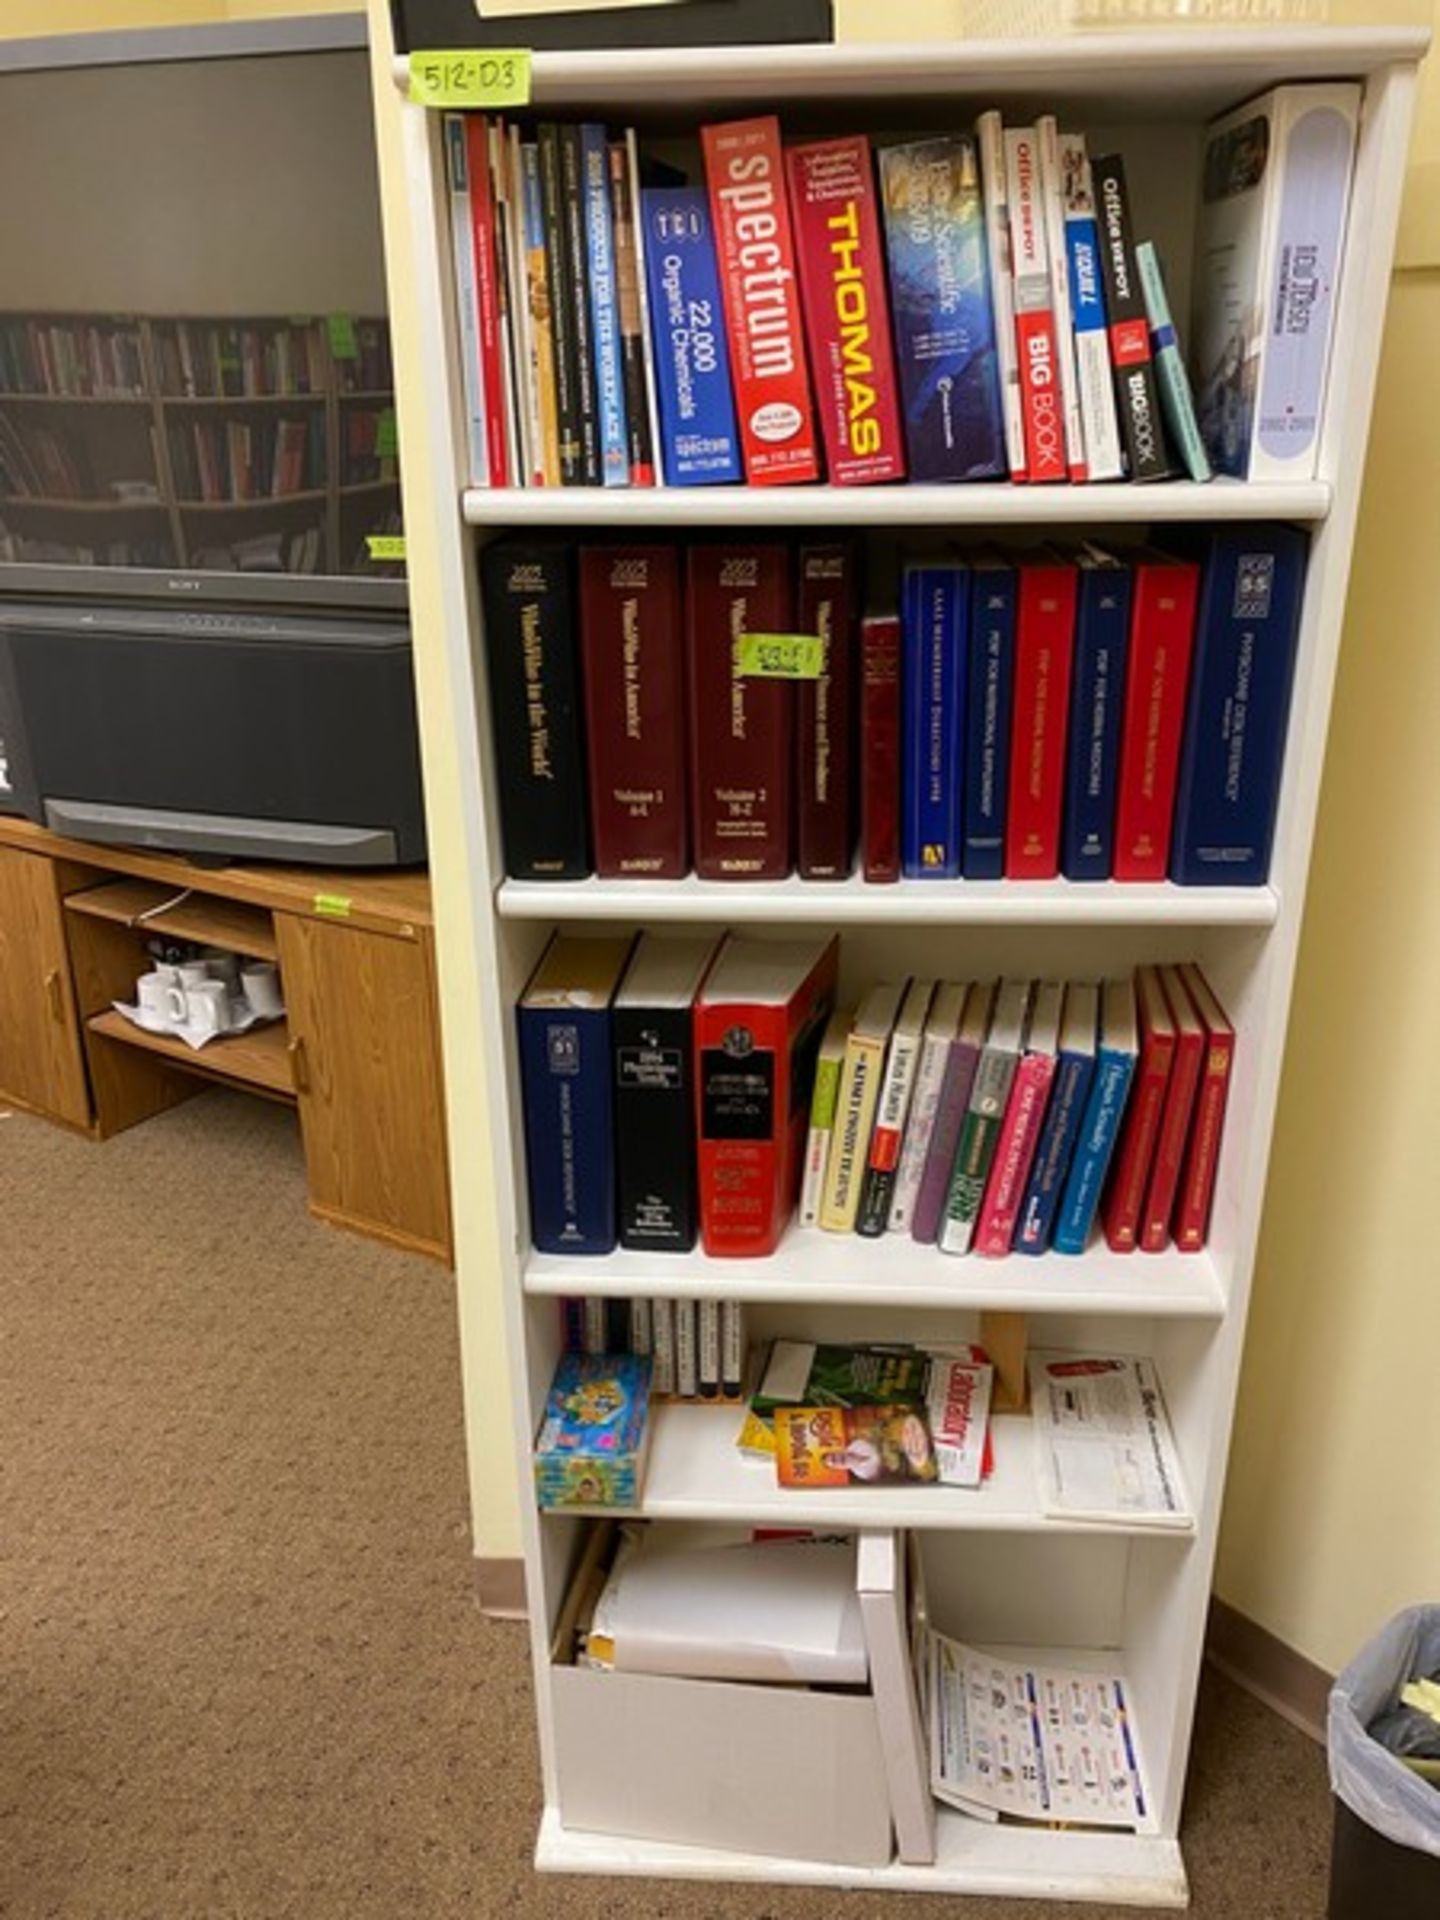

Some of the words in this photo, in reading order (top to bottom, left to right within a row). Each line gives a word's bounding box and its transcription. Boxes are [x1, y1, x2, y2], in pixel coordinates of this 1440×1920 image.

[663, 255, 686, 324] Organic
[719, 155, 796, 378] spectrum
[688, 302, 718, 371] 22,000
[828, 202, 881, 454] THOMAS
[1027, 336, 1053, 386] BIG
[671, 329, 696, 419] Chemicals
[1032, 393, 1058, 466] BOOK
[935, 1361, 980, 1450] Laboratory
